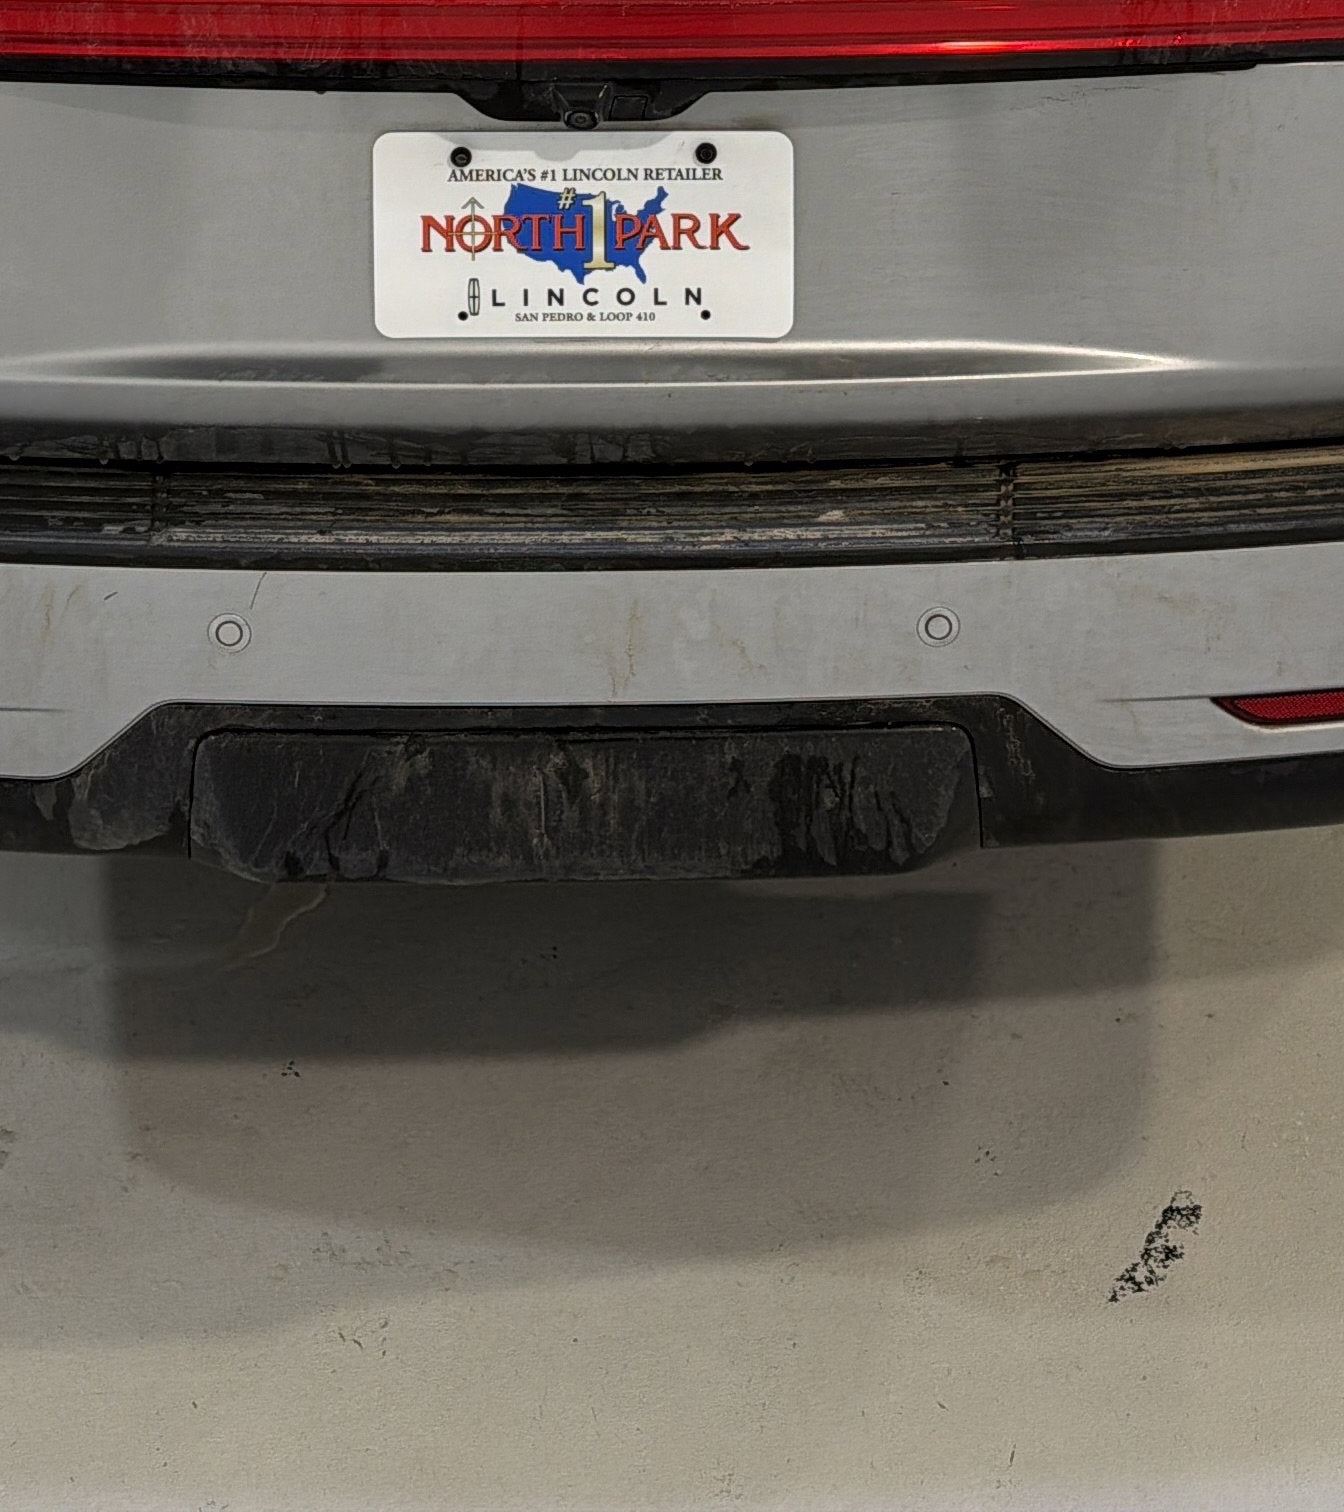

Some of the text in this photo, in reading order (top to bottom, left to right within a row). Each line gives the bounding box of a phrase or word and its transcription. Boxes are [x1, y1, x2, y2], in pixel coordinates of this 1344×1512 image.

[447, 167, 724, 182] AMERICA'S #1 LINCOLN RETAILER
[420, 213, 751, 253] NORTH PARK
[492, 287, 702, 306] LINCOLN
[515, 311, 656, 322] SAN PEDRO & LOOP 410
